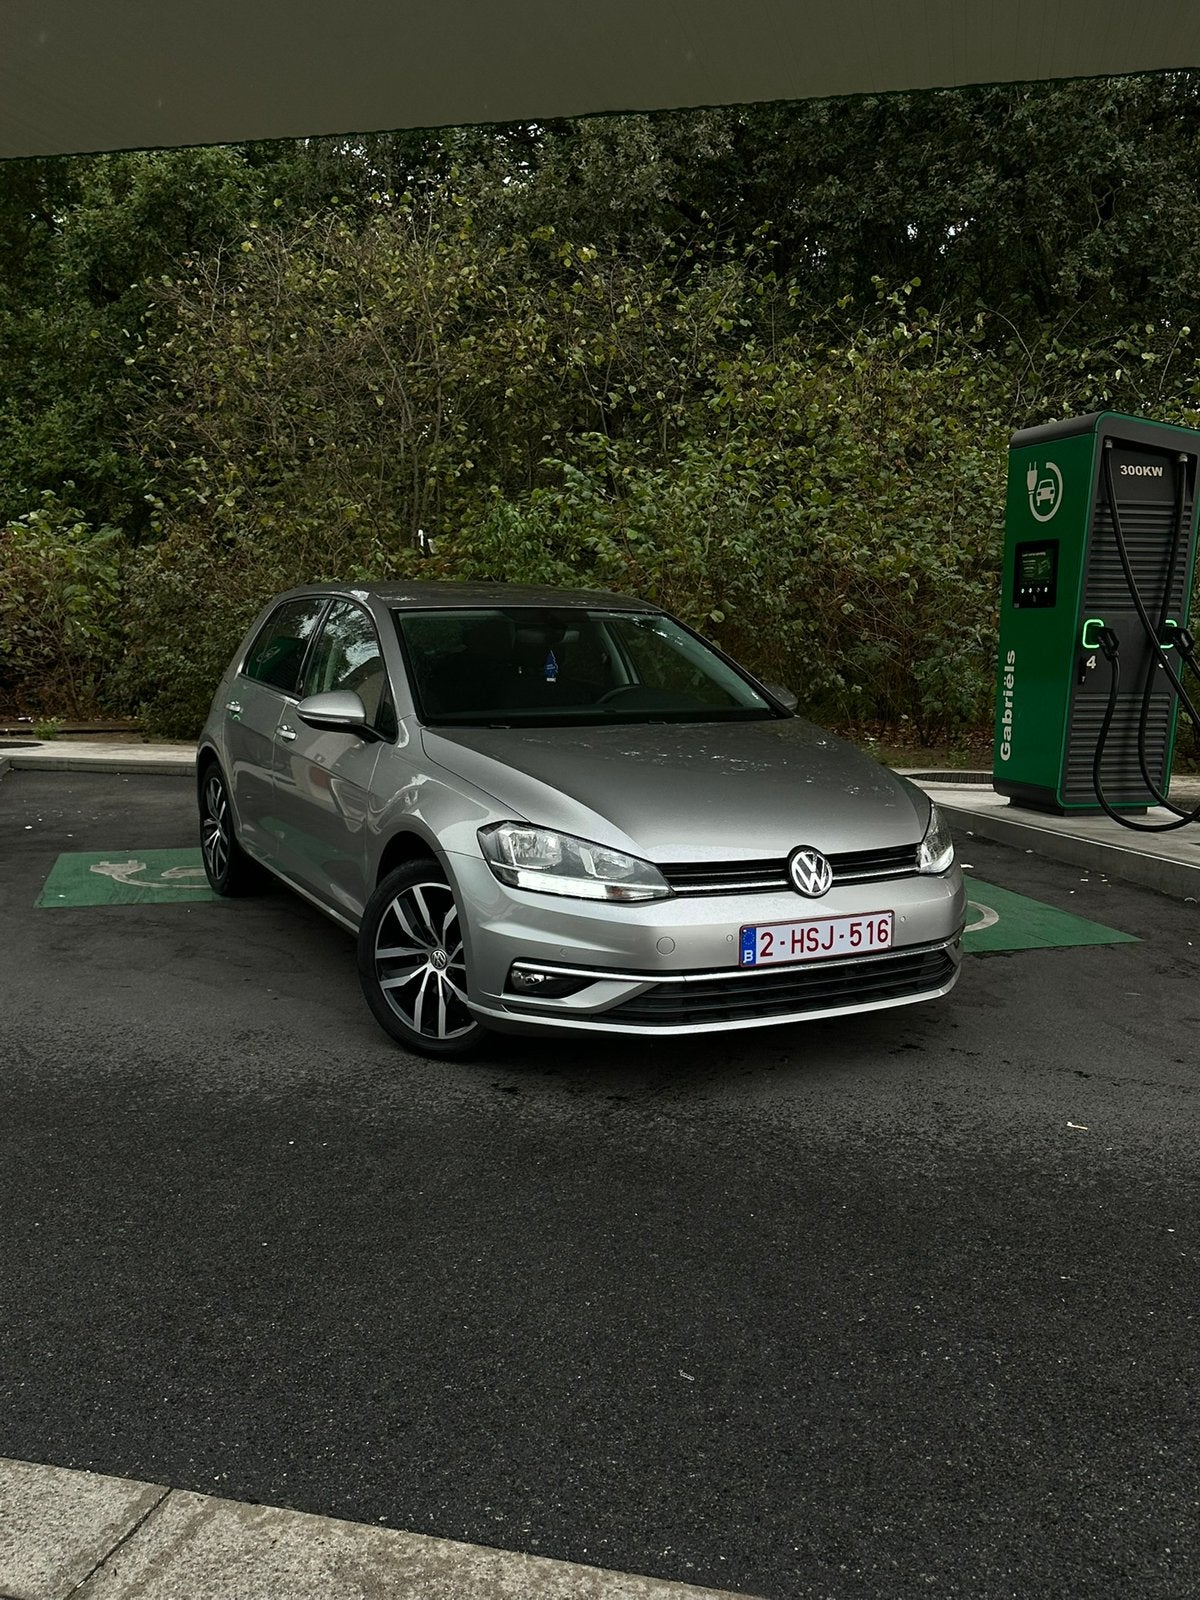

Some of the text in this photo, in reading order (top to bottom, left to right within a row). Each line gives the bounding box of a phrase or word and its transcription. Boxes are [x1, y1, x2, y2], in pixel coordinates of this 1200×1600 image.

[1120, 465, 1163, 477] 300KW
[1086, 655, 1096, 669] 4
[1000, 649, 1016, 761] Gabriëls
[791, 851, 833, 896] VW
[760, 919, 889, 958] 2-HSJ-516
[744, 950, 753, 962] B
